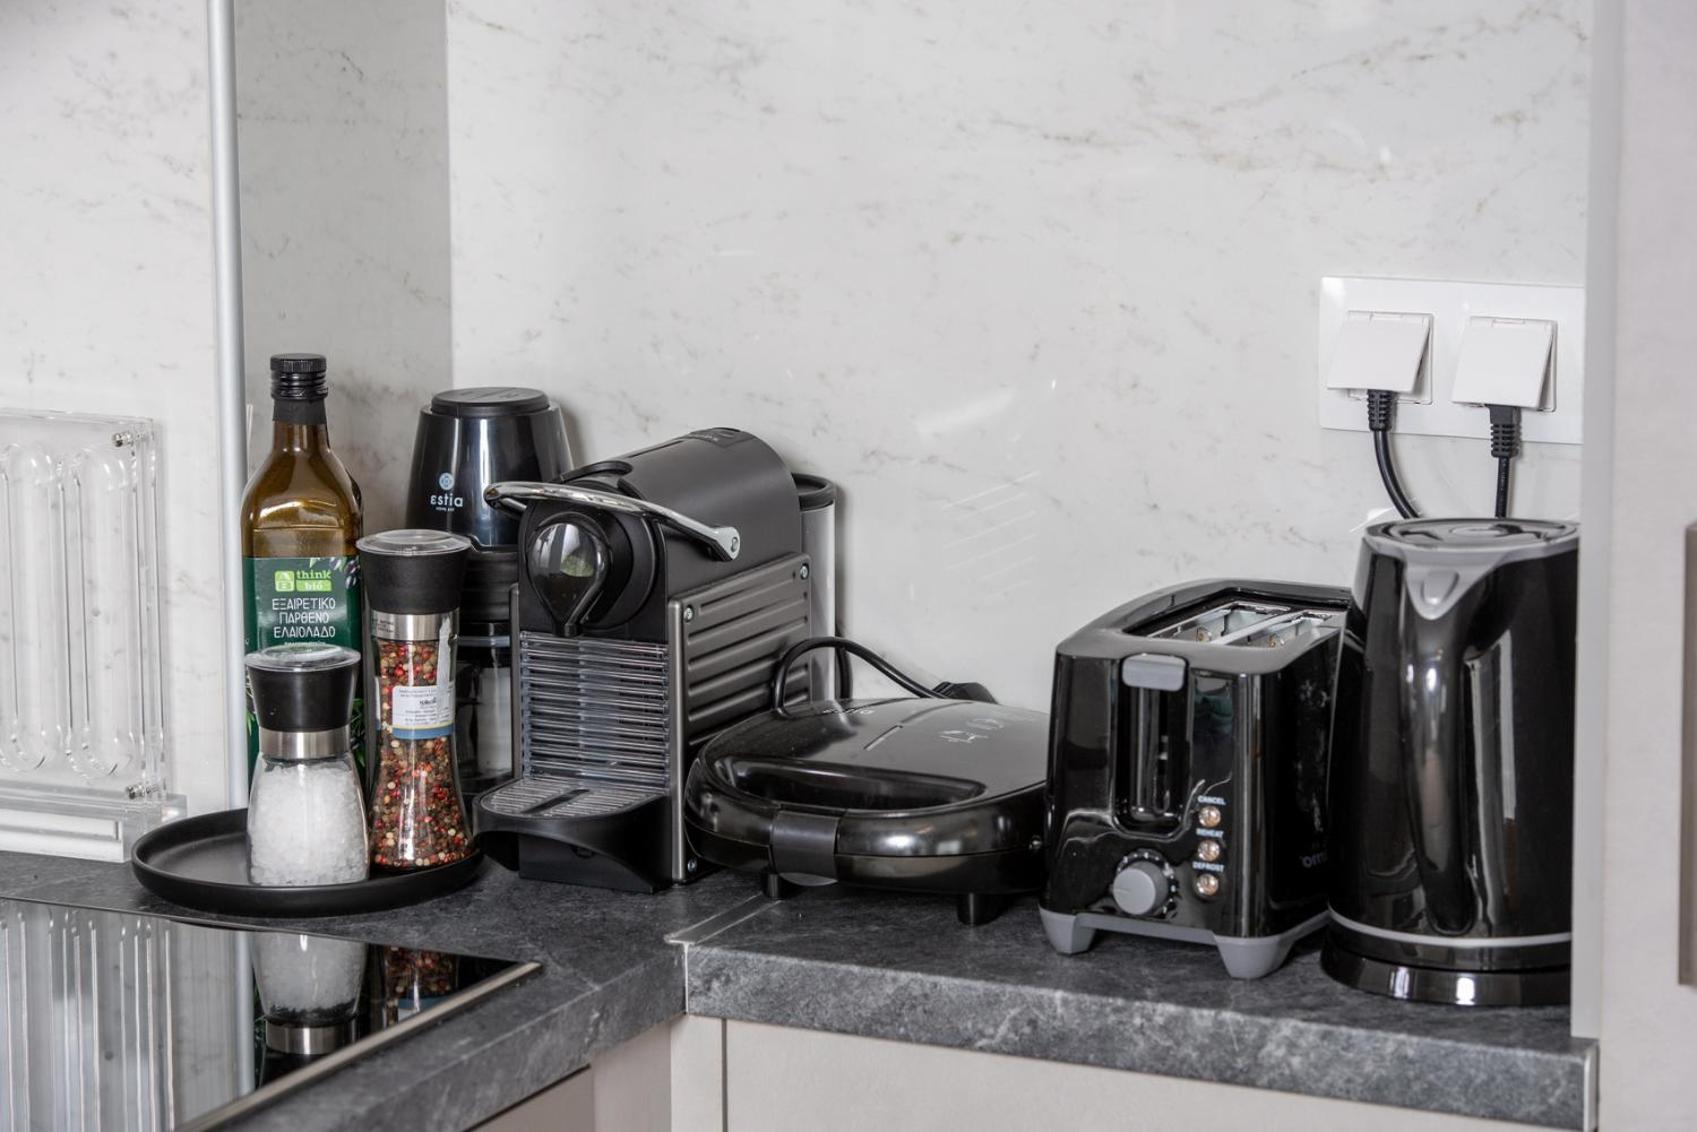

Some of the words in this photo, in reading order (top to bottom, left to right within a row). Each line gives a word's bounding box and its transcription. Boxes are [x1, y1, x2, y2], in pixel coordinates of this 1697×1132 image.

[296, 569, 332, 580] think
[272, 597, 336, 611] ΕΞΑΙΡΕΤΙΚΟ
[279, 611, 330, 624] ΠΑΡΘΕΝΟ
[273, 626, 336, 639] ΕΛΑΙΟΛΑΔΟ
